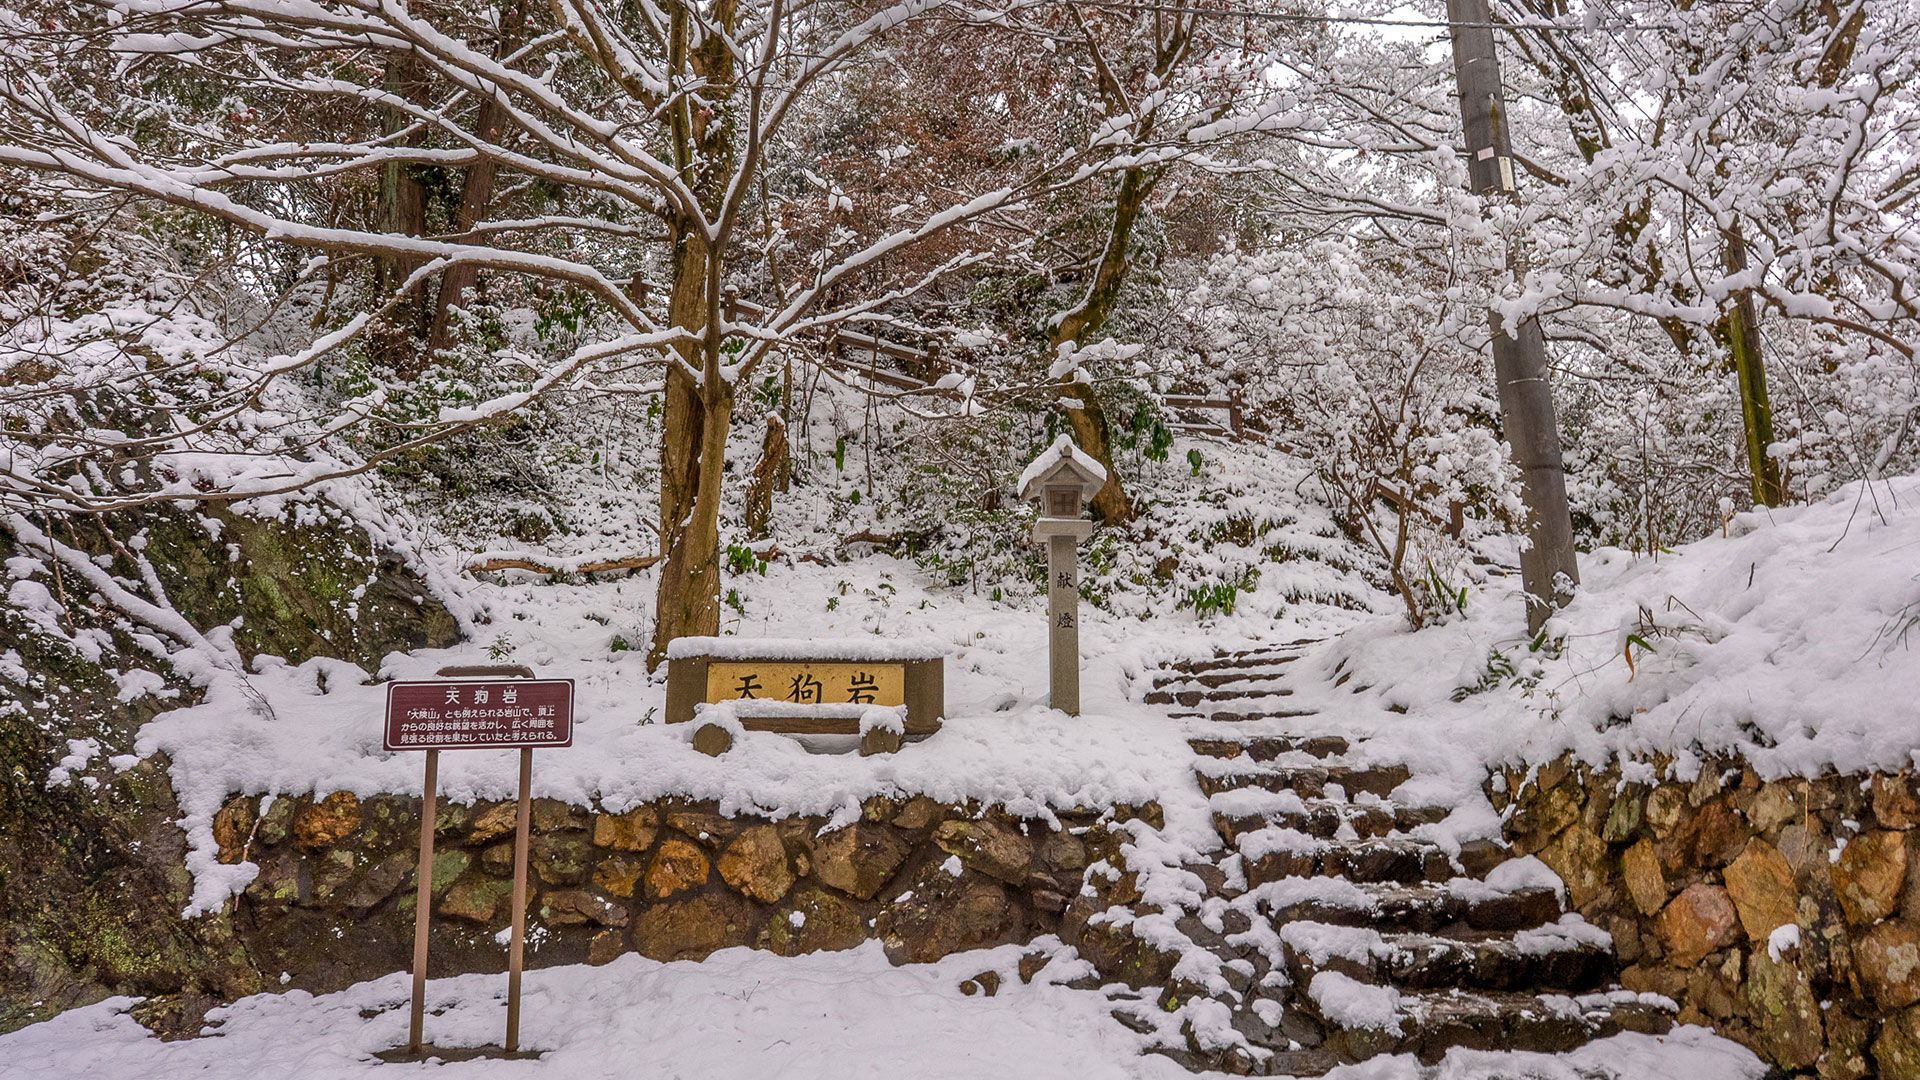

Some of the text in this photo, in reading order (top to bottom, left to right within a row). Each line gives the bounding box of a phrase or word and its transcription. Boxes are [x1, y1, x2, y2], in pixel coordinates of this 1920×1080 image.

[1056, 571, 1074, 629] 献燈
[444, 688, 518, 705] 天狗岩
[734, 671, 880, 704] 天狗岩
